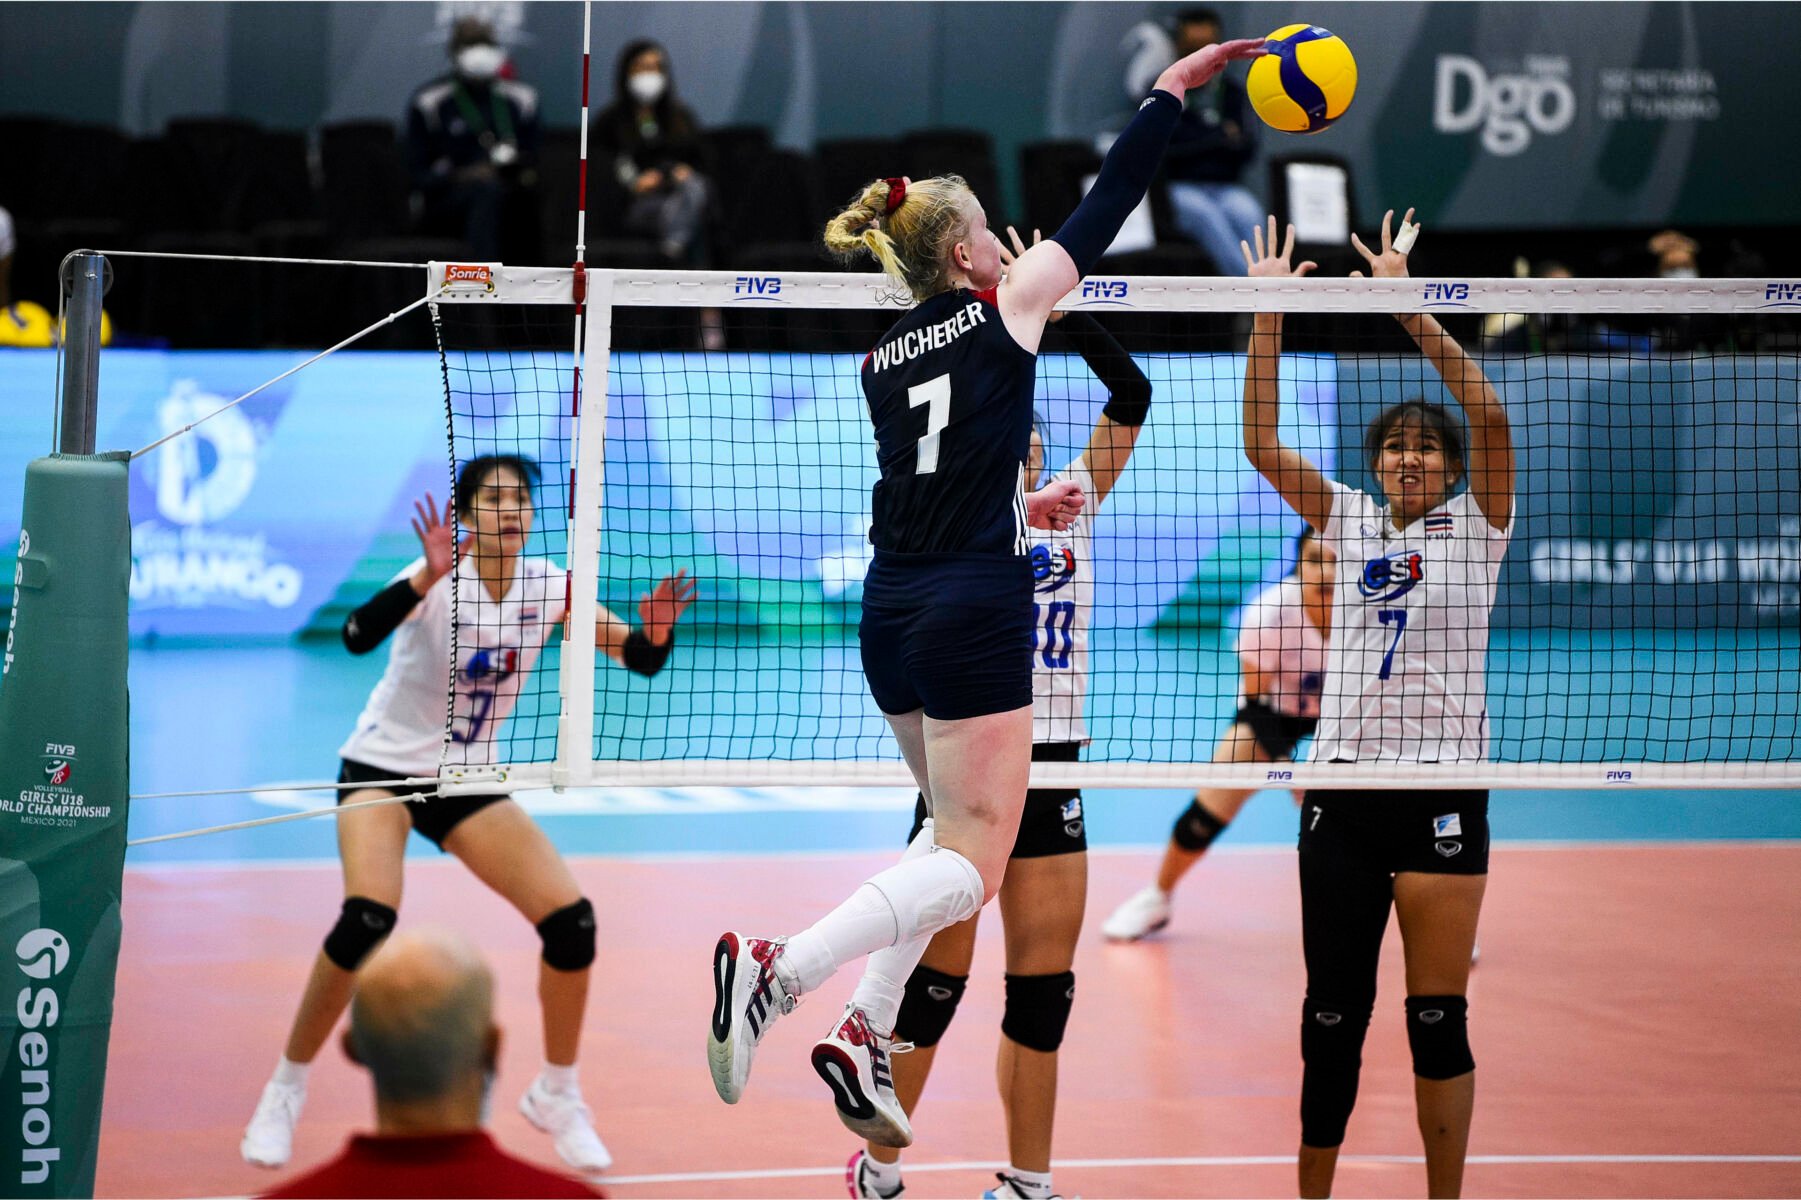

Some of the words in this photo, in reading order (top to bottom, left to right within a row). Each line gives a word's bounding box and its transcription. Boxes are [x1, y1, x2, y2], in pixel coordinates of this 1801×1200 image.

[1434, 54, 1576, 157] Dgo
[735, 277, 782, 294] FIVB
[1082, 281, 1128, 298] FIVB
[1423, 283, 1469, 300] FIVB
[873, 301, 987, 374] WUCHERER
[907, 372, 951, 475] 7
[1378, 609, 1408, 681] 7
[45, 743, 76, 756] FIVB
[1267, 771, 1293, 780] FIVB
[1606, 771, 1632, 780] FIVB
[33, 784, 73, 793] VOLLEYBALL
[61, 795, 84, 806] U18
[27, 803, 111, 818] CHAMPIONSHIP
[1310, 806, 1322, 831] 7
[56, 818, 77, 827] 2021
[16, 987, 61, 1184] Senoh
